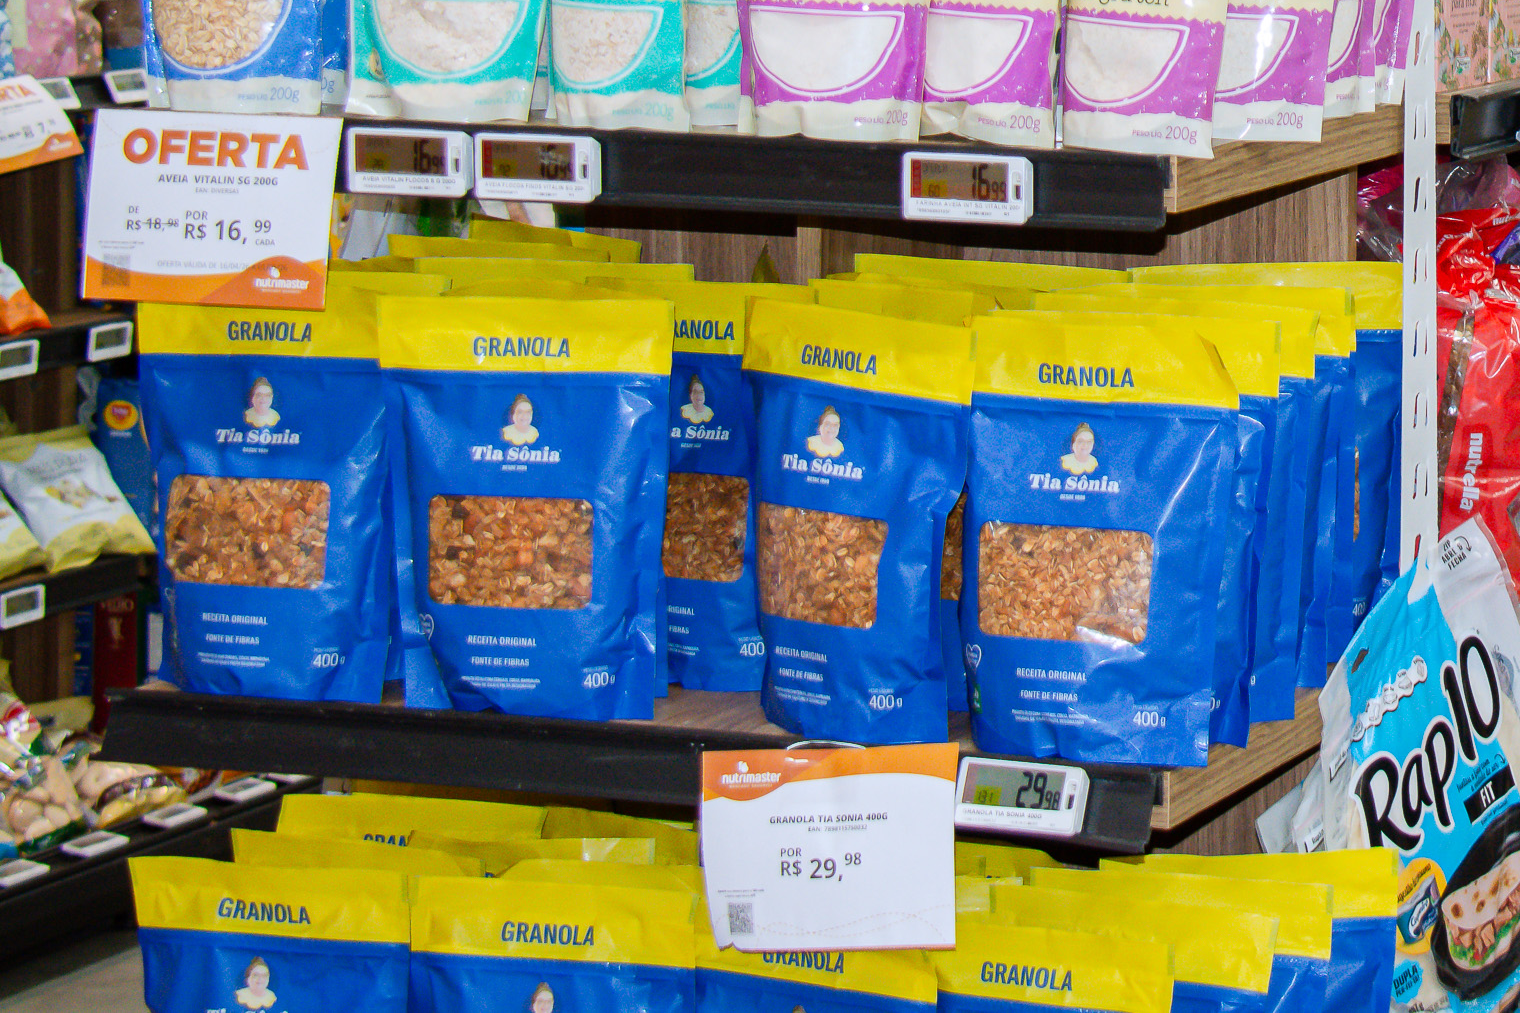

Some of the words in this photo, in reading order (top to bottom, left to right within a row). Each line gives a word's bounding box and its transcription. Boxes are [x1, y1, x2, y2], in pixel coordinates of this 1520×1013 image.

[886, 109, 909, 126] 200g
[1010, 115, 1041, 133] 200g
[1277, 111, 1303, 128] 200g
[1166, 126, 1197, 143] 200g
[123, 129, 309, 171] OFERTA
[158, 174, 188, 183] AVEIA
[194, 175, 234, 184] VITALIN
[237, 176, 251, 185] SG
[253, 177, 278, 186] 200G
[128, 206, 139, 214] DE
[186, 211, 208, 220] POR
[127, 219, 141, 231] R$
[185, 224, 207, 241] R$
[255, 220, 272, 233] 99
[256, 278, 309, 289] nutrimaster
[227, 320, 312, 342] GRANOLA
[473, 336, 571, 359] GRANOLA
[801, 344, 877, 375] GRANOLA
[1038, 362, 1135, 388] GRANOLA
[216, 428, 243, 444] Tia
[247, 429, 300, 445] Sônia
[690, 424, 730, 442] Sônia
[472, 444, 503, 462] Tia
[508, 445, 560, 464] Sônia
[1460, 432, 1484, 513] nutrella
[1029, 473, 1061, 490] Tia
[1065, 475, 1120, 493] Sônia
[468, 635, 498, 646] RECEITA
[499, 636, 536, 647] ORIGINAL
[472, 656, 492, 665] FONTE
[504, 658, 529, 667] FIBRAS
[1017, 668, 1046, 679] RECEITA
[1048, 669, 1087, 682] ORIGINAL
[1020, 690, 1040, 699] FONTE
[1053, 692, 1078, 702] FIBRAS
[722, 772, 781, 784] nutrimaster
[1016, 771, 1047, 808] 29
[1480, 781, 1495, 808] FIT
[770, 815, 814, 824] GRANOLA
[818, 815, 833, 823] TIA
[836, 814, 863, 822] SONIA
[866, 813, 888, 821] 400G
[781, 848, 802, 856] POR
[781, 860, 802, 877] R$
[845, 853, 861, 865] 98
[217, 897, 311, 925] GRANOLA
[501, 920, 595, 947] GRANOLA
[980, 960, 1073, 991] GRANOLA
[1393, 965, 1418, 989] DUPLA
